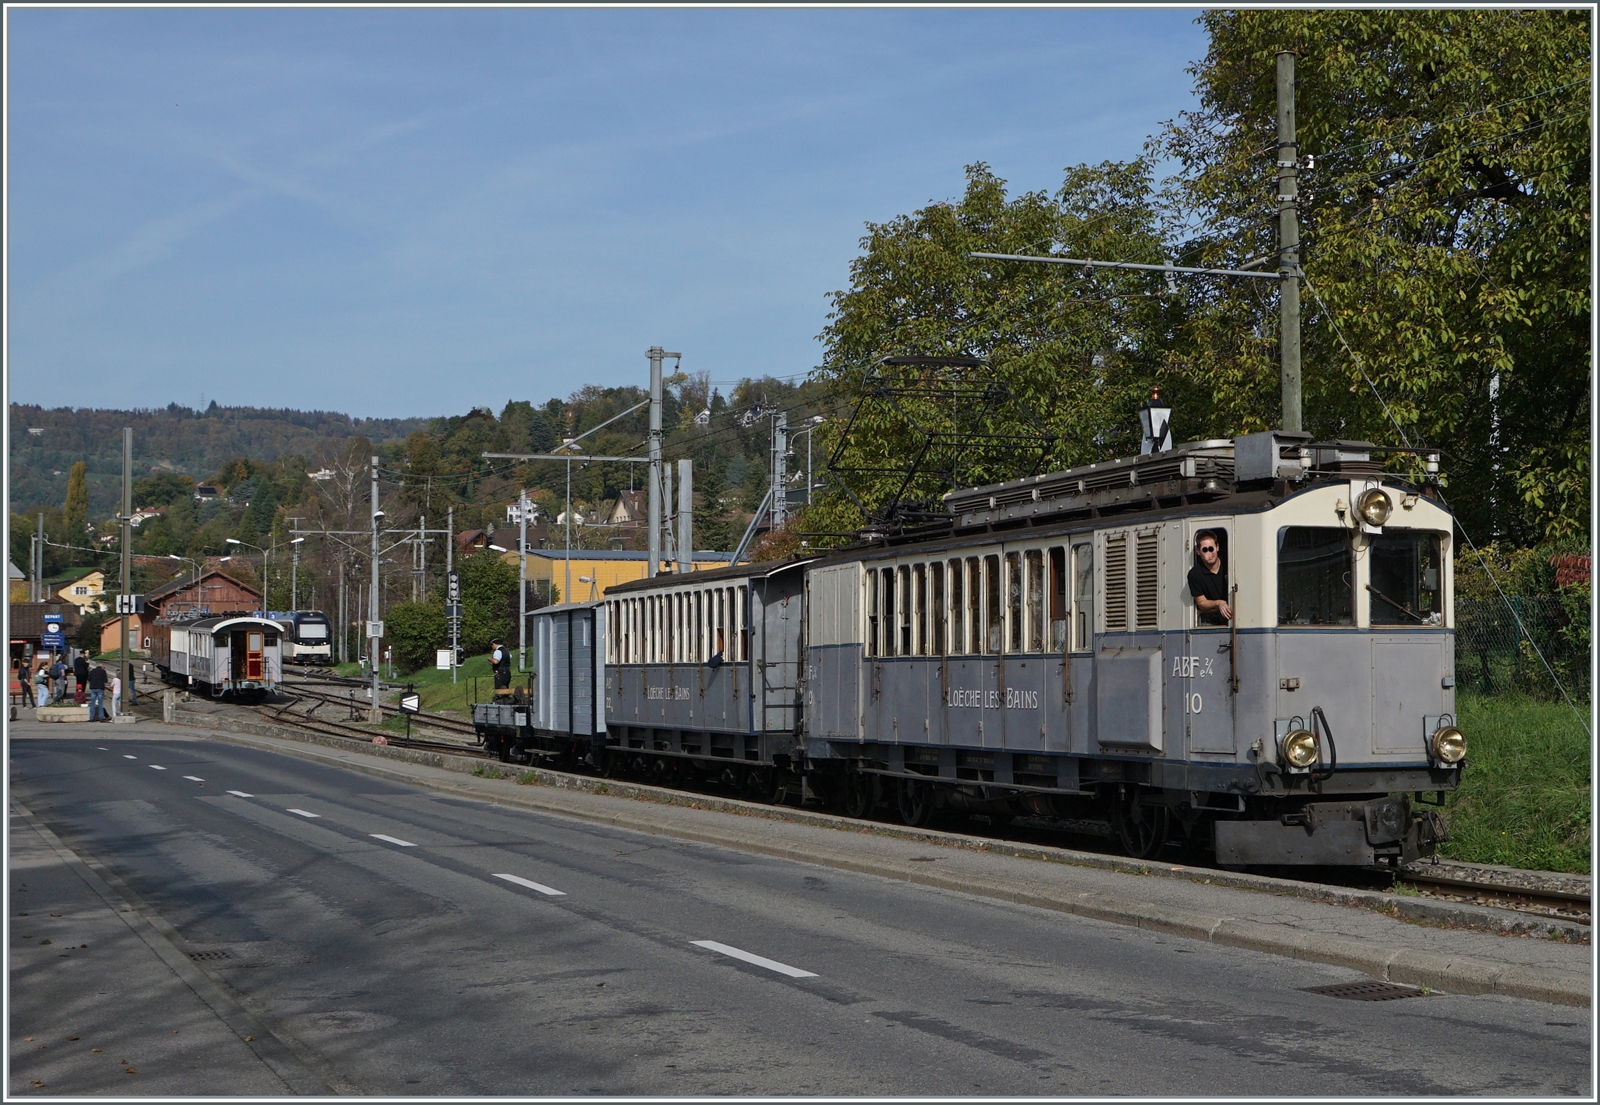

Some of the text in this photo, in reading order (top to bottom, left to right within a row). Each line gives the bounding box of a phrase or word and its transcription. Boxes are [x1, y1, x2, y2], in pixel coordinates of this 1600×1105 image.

[674, 685, 690, 701] BAINS
[948, 687, 1038, 709] LOÈCHE LES BAINS
[1185, 692, 1203, 714] 10
